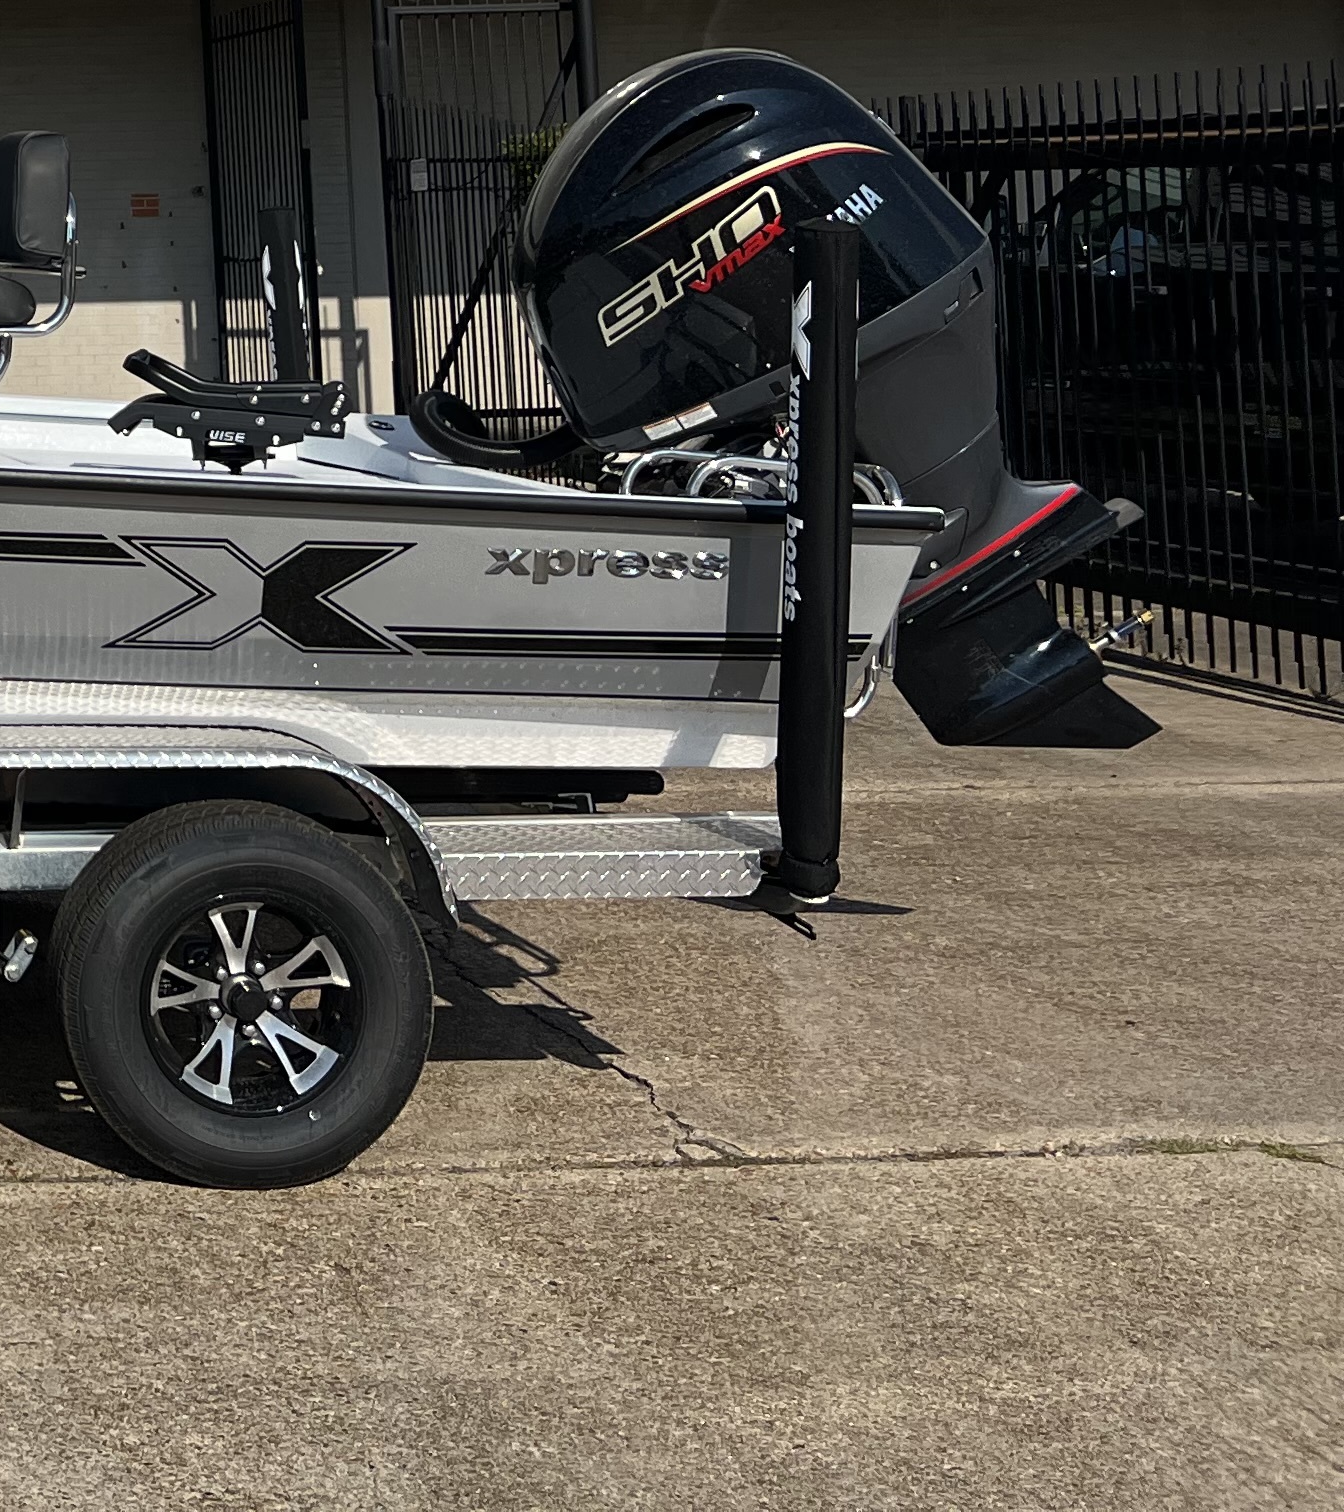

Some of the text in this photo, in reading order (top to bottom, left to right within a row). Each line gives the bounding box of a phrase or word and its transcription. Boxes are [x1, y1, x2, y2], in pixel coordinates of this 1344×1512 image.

[597, 185, 782, 348] SHO
[484, 546, 730, 585] xpress
[783, 513, 804, 622] boats
